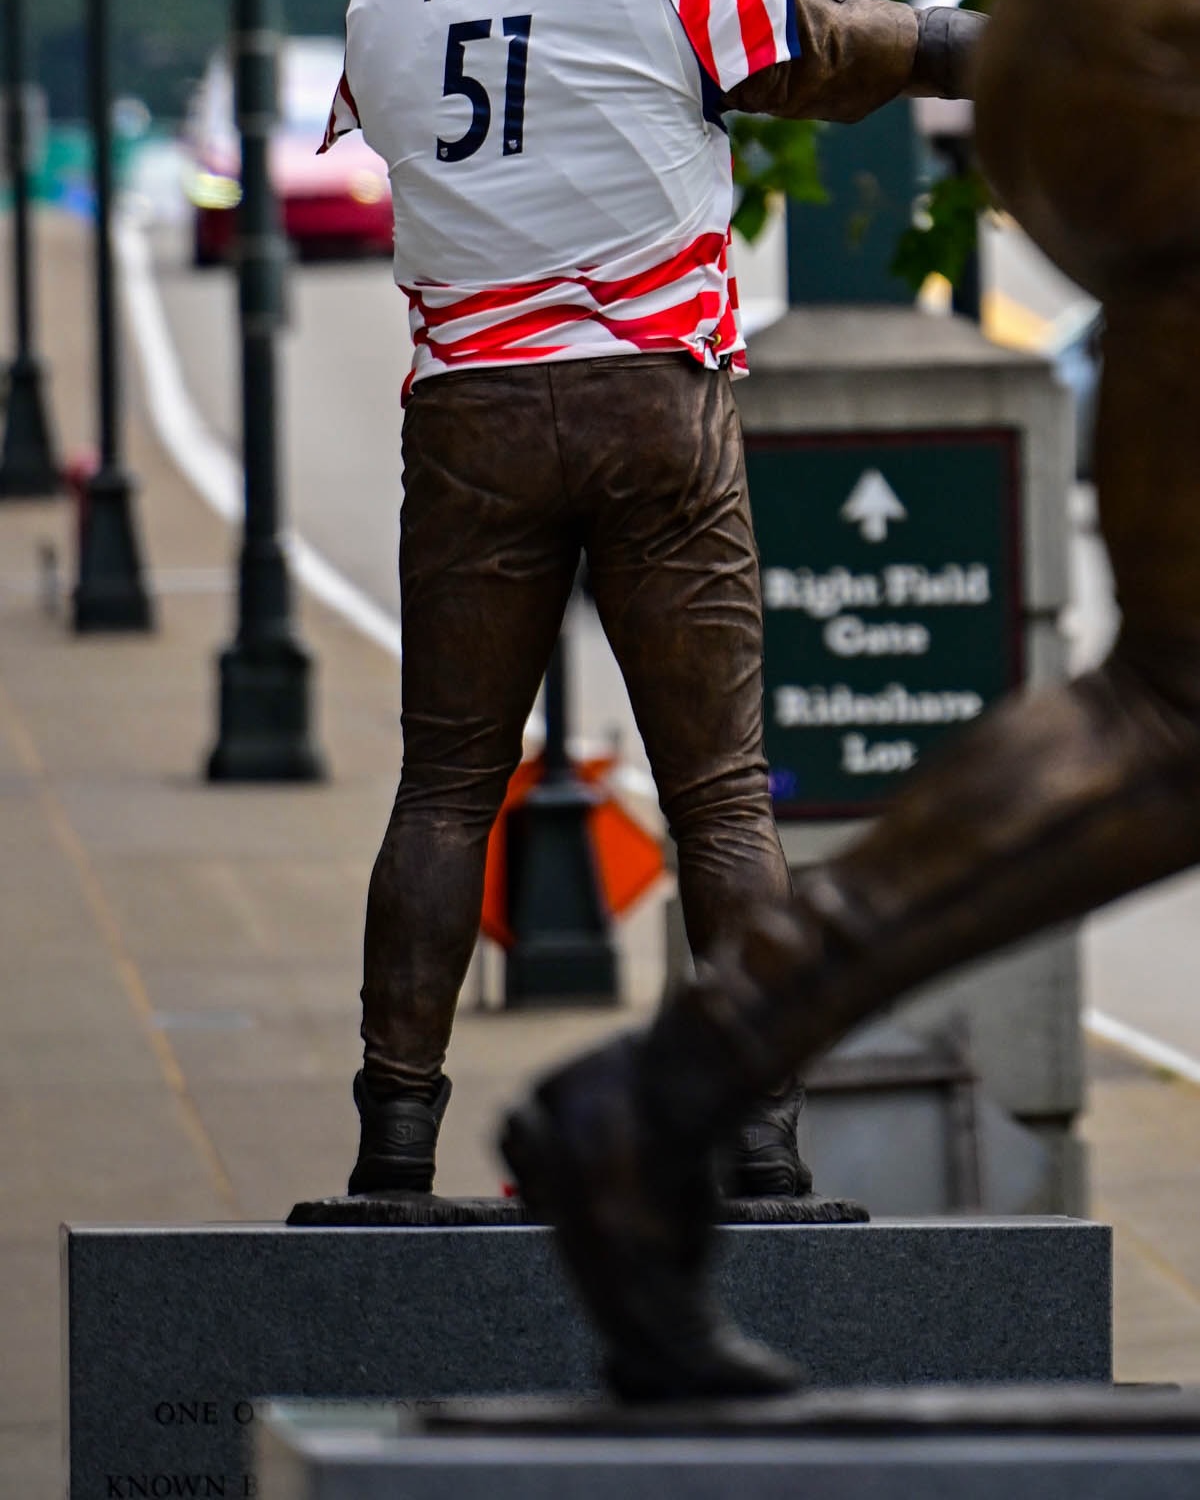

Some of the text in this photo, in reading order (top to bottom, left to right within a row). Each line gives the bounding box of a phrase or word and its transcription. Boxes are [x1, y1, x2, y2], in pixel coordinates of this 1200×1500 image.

[437, 14, 532, 162] 51
[763, 564, 989, 618] Right Field
[824, 614, 929, 656] Gate
[775, 684, 983, 727] Rideshare
[842, 733, 917, 774] Lot
[154, 1401, 258, 1425] ONE O
[105, 1475, 225, 1498] KNOWN
